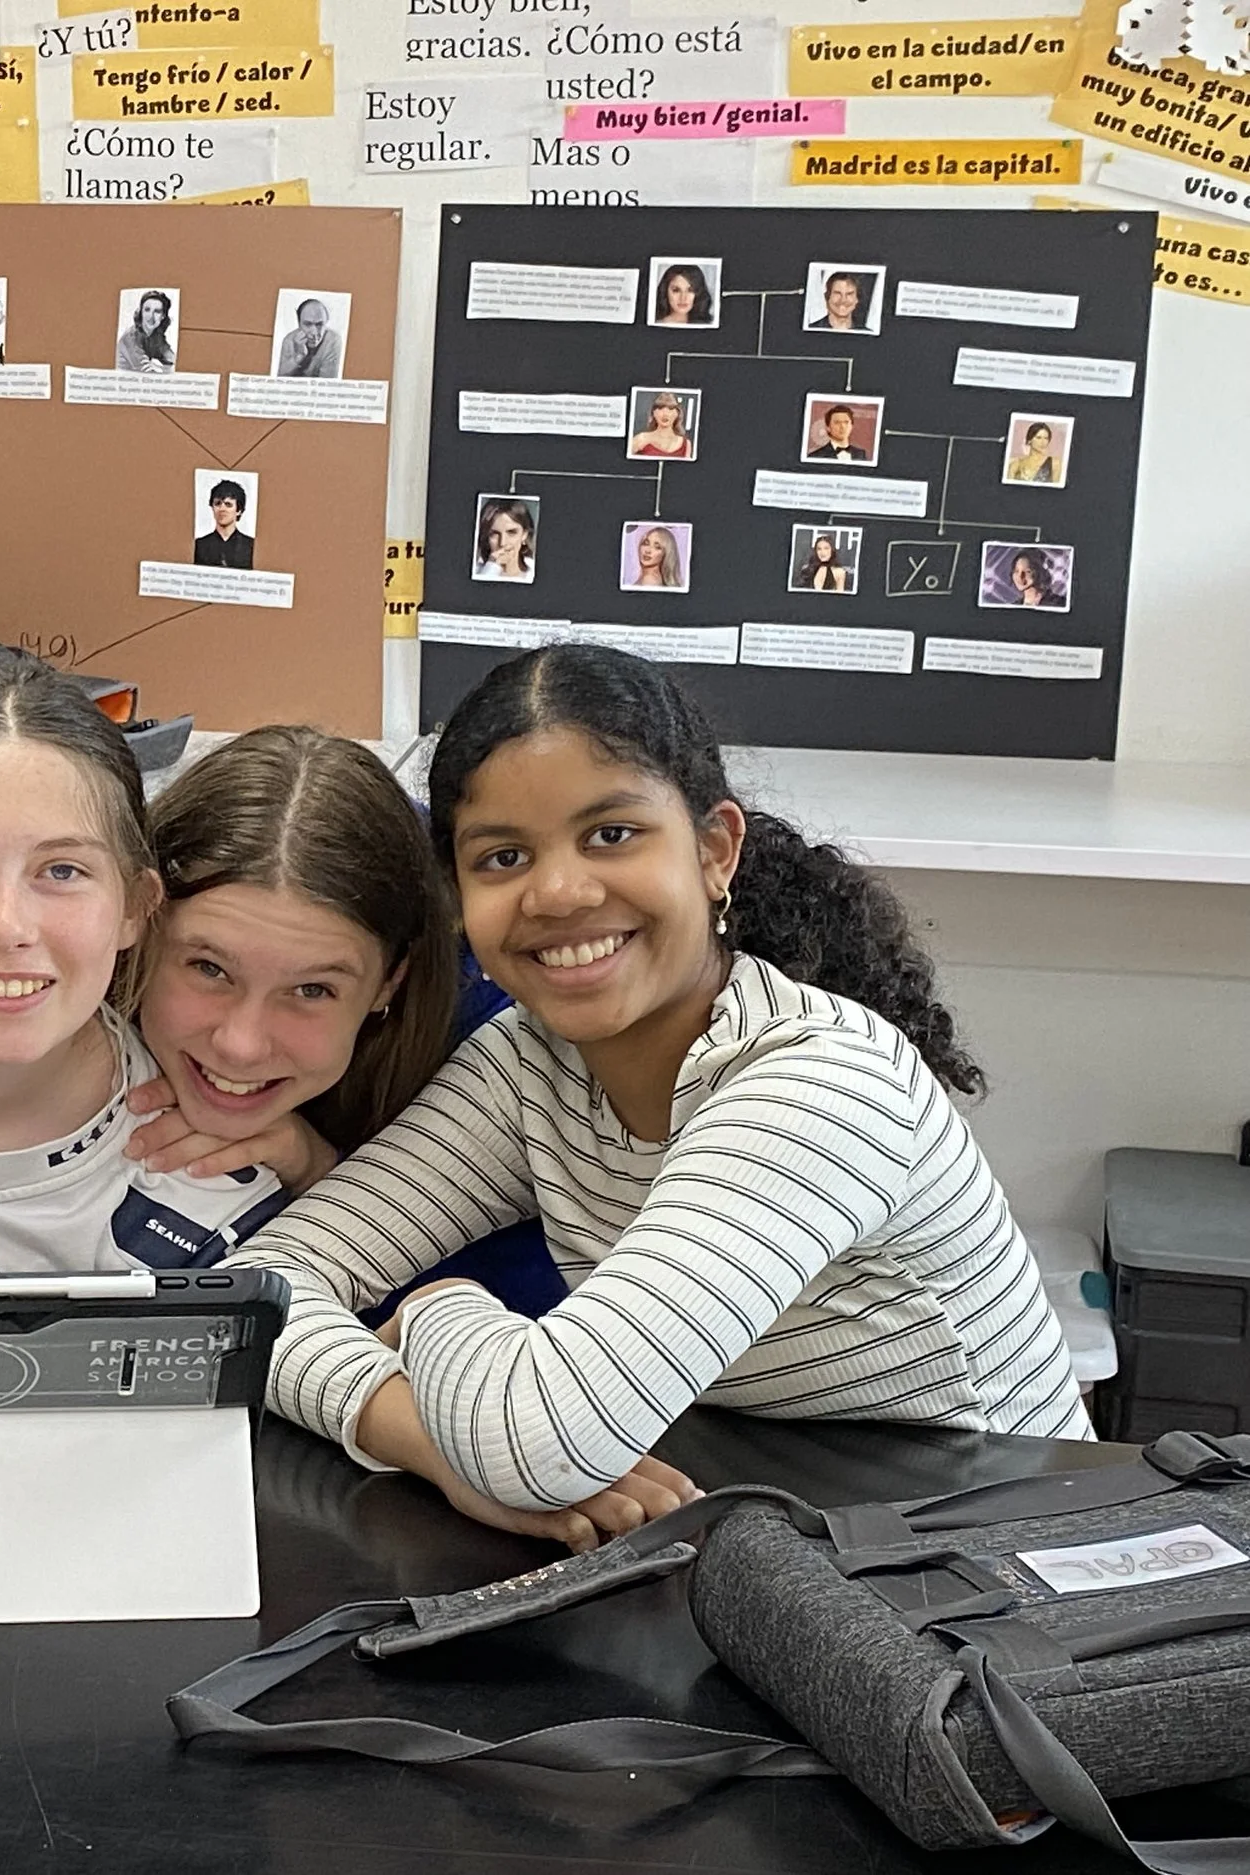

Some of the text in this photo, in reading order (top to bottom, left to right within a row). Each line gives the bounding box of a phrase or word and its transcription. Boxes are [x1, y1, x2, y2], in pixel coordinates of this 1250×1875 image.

[136, 4, 240, 23] ntento-a
[38, 18, 133, 58] ¿Y tú?
[406, 30, 532, 62] gracias.
[547, 21, 743, 56] ¿Cómo está
[807, 33, 1065, 61] Vivo en la ciudad/en
[93, 59, 313, 93] Tengo frío / calor /
[547, 68, 655, 101] usted?
[871, 70, 992, 95] el campo.
[122, 91, 281, 116] hambre / sed.
[366, 91, 456, 125] Estoy
[1081, 73, 1238, 131] muy bonita/
[596, 110, 648, 133] Muy
[654, 105, 707, 127] bien
[67, 127, 215, 158] ¿Cómo te
[364, 132, 492, 171] regular.
[1094, 110, 1126, 133] un
[1130, 123, 1226, 163] edificio
[611, 144, 631, 166] o
[805, 153, 1062, 182] Madrid es la capital.
[65, 168, 184, 200] llamas?
[1184, 176, 1239, 205] Vivo
[1156, 236, 1202, 258] una
[90, 1335, 231, 1352] FRENCH
